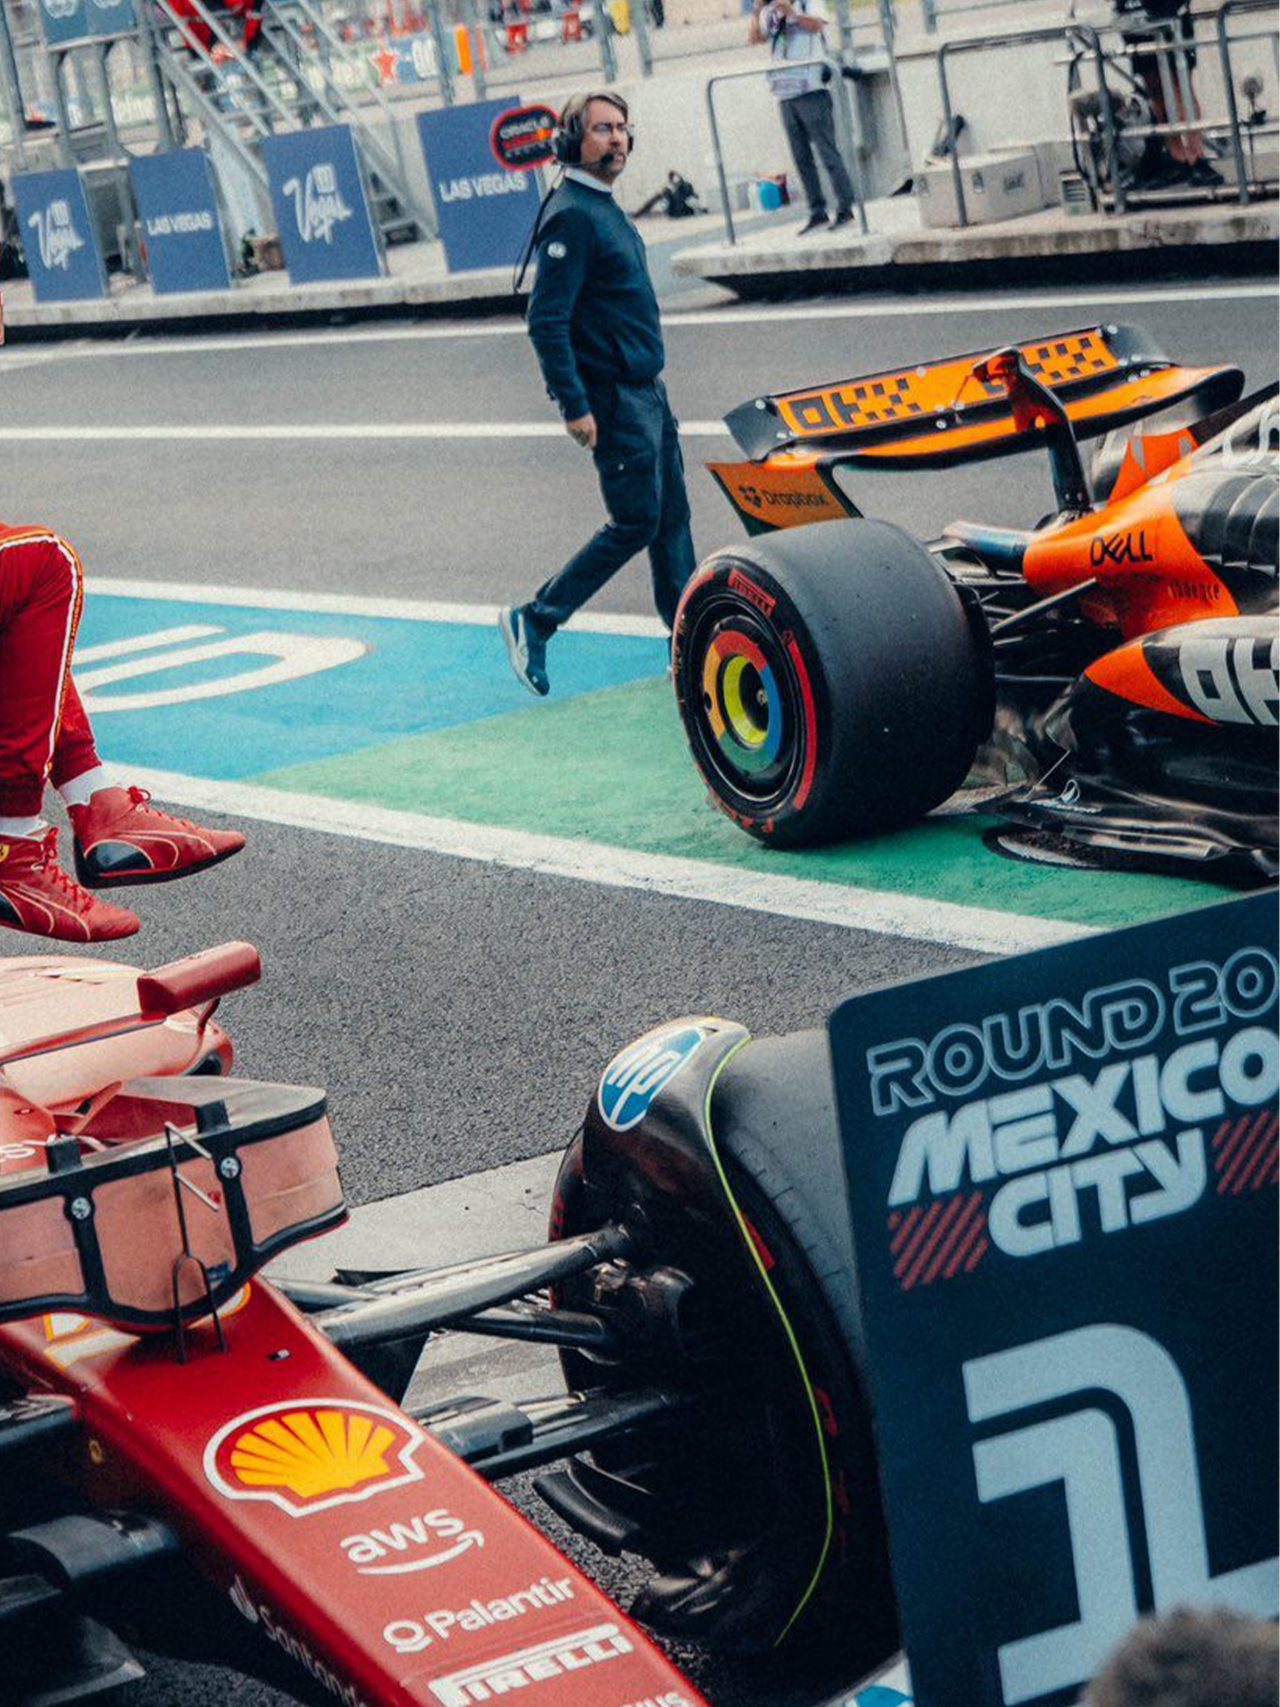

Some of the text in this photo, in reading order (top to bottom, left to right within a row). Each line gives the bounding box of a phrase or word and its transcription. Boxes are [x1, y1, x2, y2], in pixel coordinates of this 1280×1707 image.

[439, 172, 529, 203] LAS VEGAS
[147, 211, 213, 236] LAS VEGAS
[761, 489, 826, 508] Dropbox
[1090, 530, 1153, 566] DELL
[867, 946, 1280, 1117] ROUND 20
[887, 1026, 1280, 1207] MEXICO
[988, 1127, 1208, 1258] CITY
[340, 1508, 465, 1563] aws
[424, 1577, 576, 1640] Palantir
[427, 1623, 634, 1707] PIRELLI
